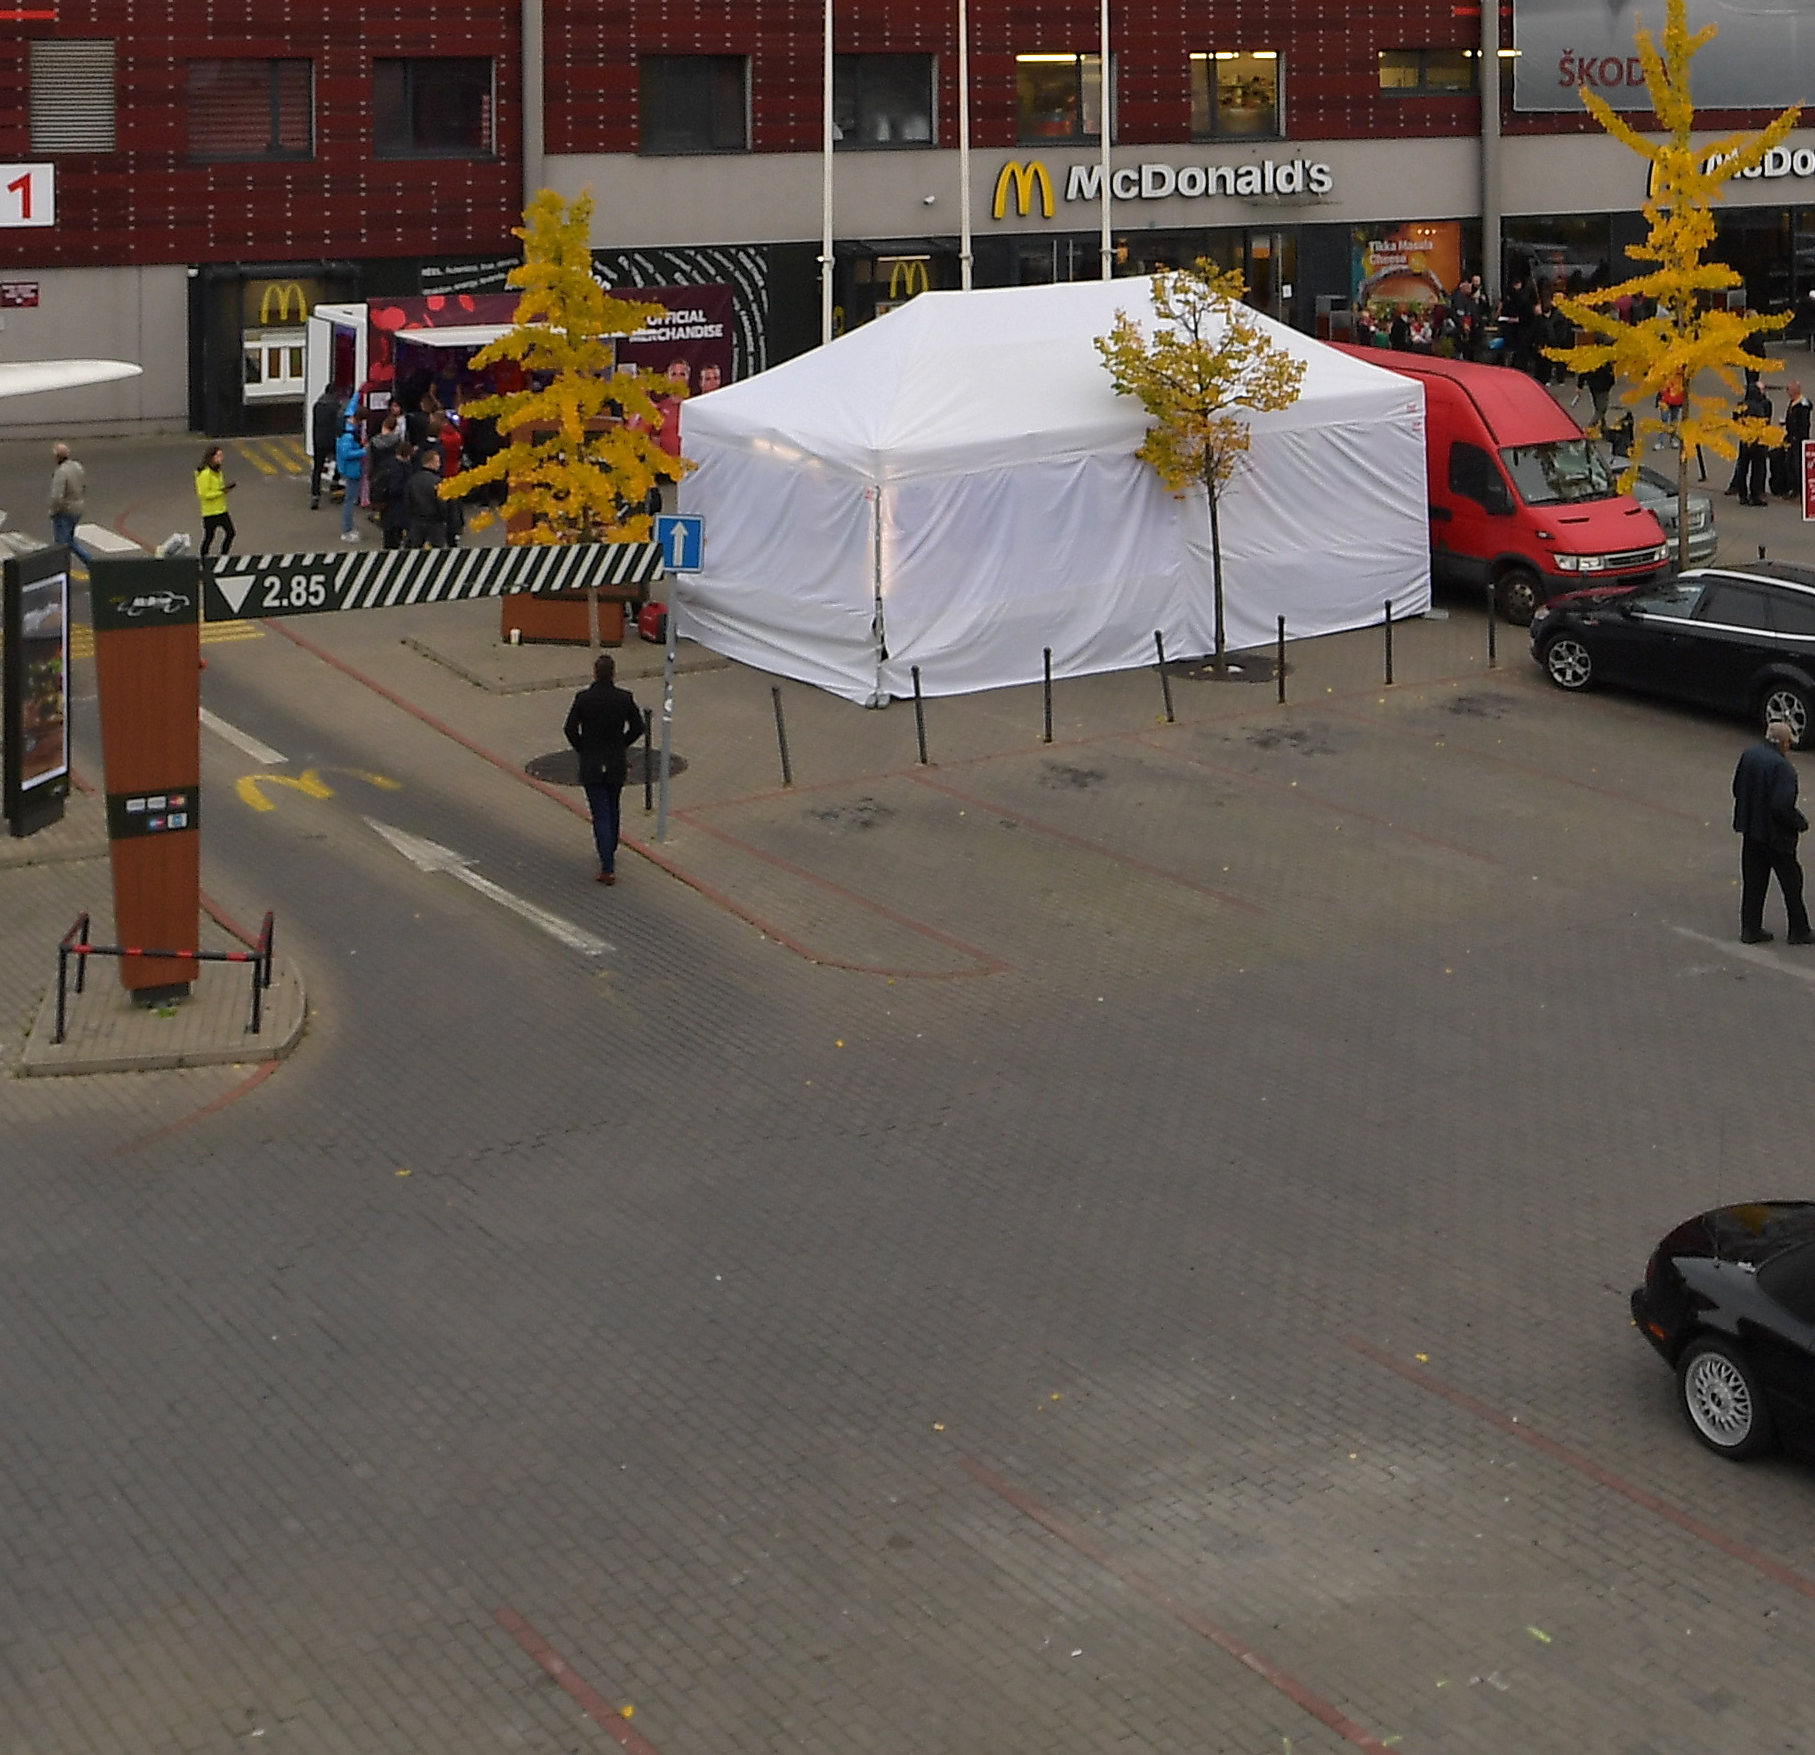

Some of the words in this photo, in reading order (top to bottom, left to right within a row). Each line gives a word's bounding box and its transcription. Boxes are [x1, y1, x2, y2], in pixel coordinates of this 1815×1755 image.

[6, 173, 32, 220] 1
[1066, 160, 1334, 201] McDonald's
[262, 575, 326, 607] 2.85
